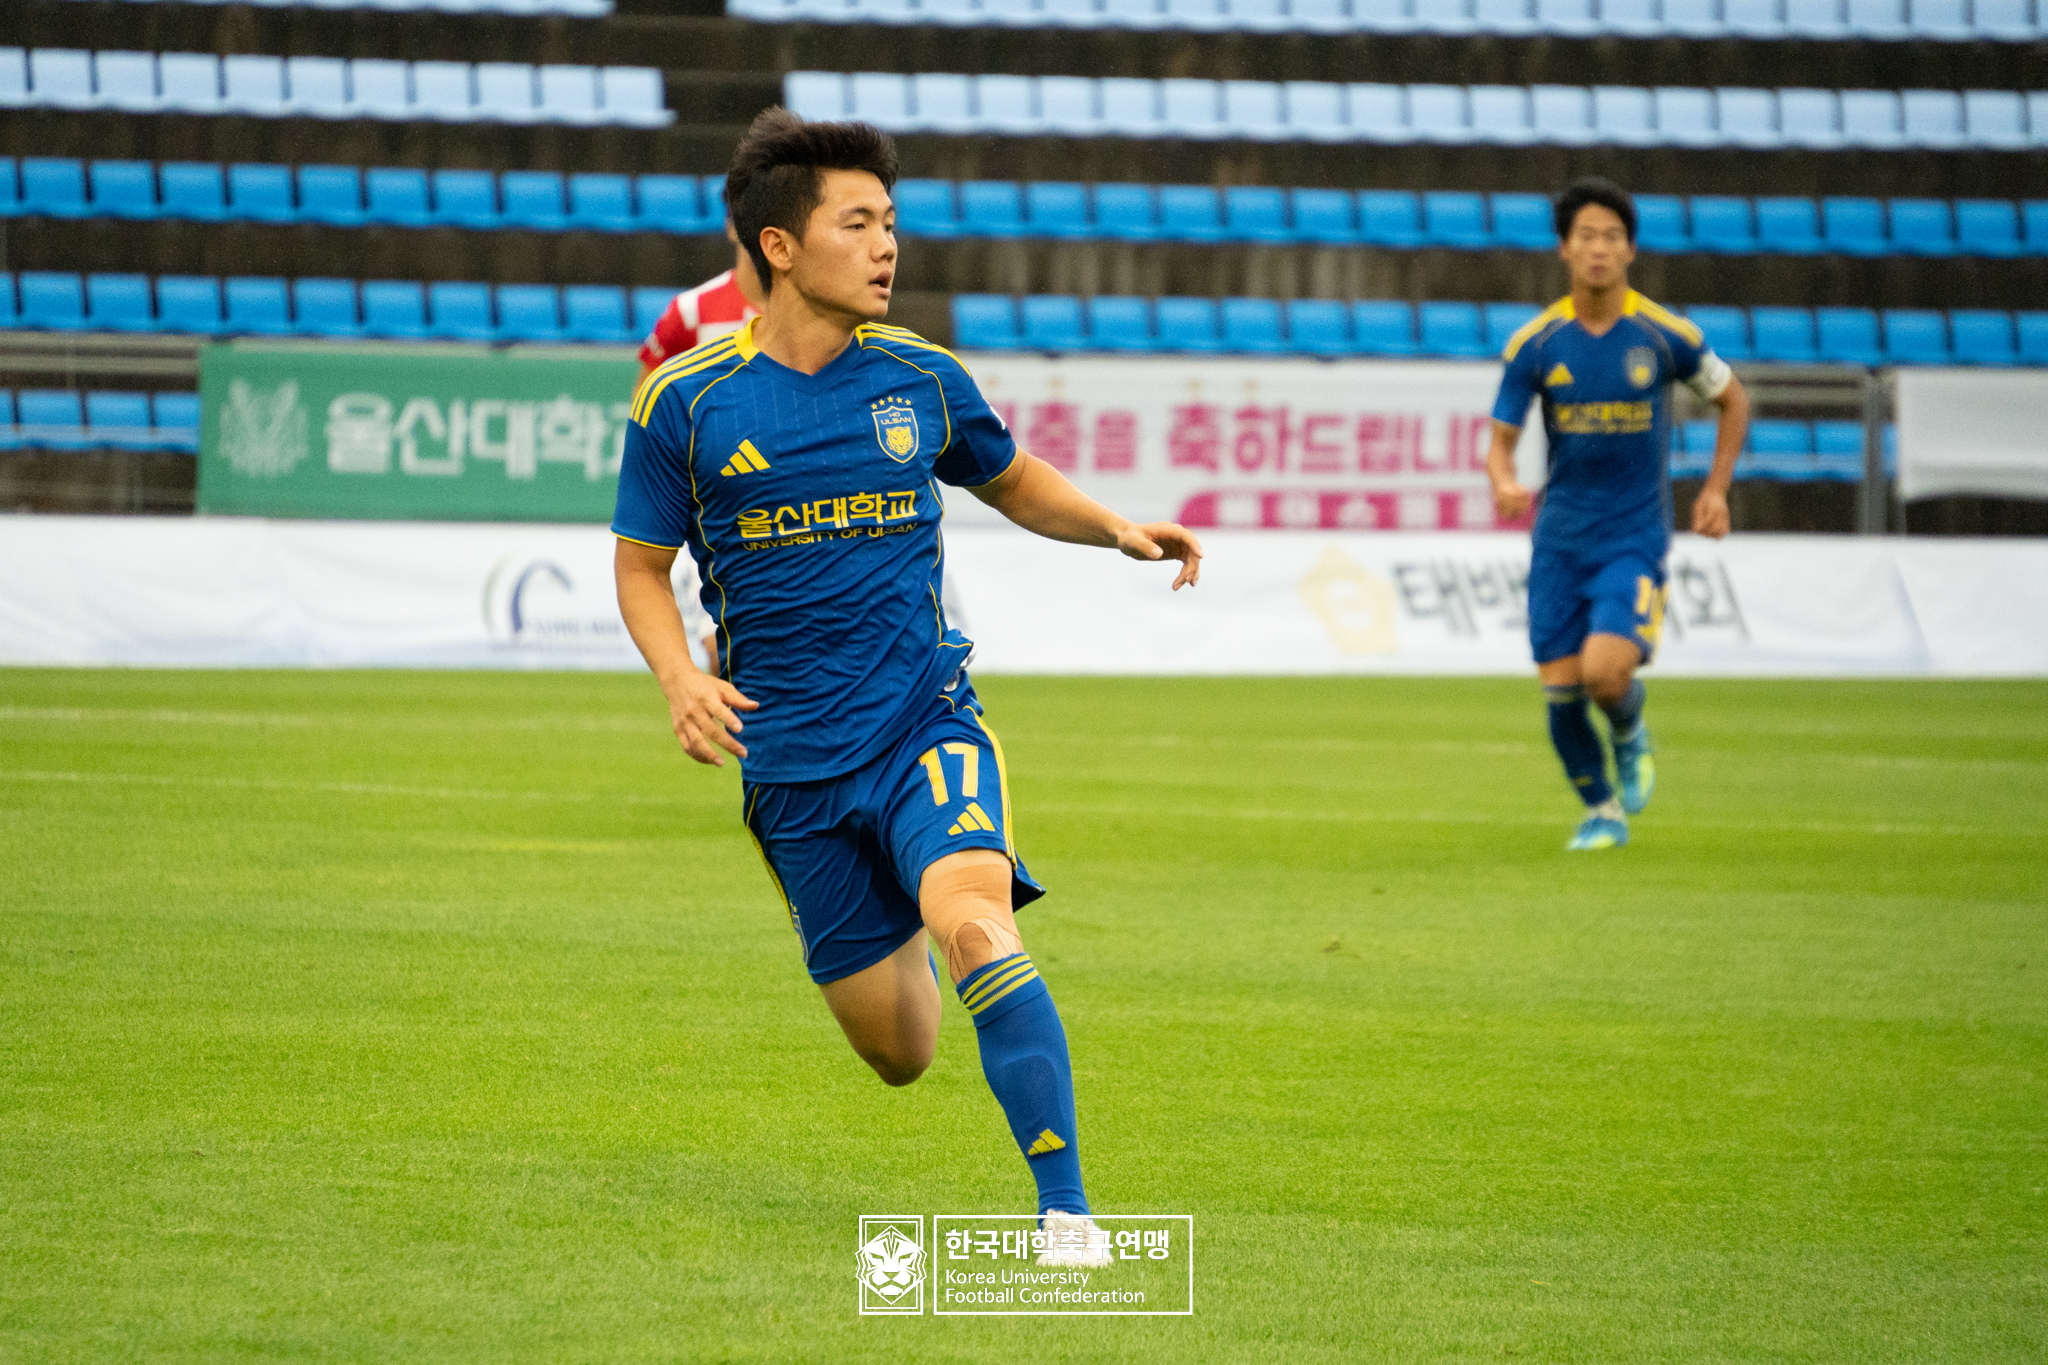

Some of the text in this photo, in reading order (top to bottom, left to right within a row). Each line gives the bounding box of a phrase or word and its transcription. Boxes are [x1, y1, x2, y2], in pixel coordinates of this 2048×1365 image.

[881, 417, 911, 425] ULSAN
[737, 491, 918, 538] 울산대학교
[742, 522, 918, 551] UNIVERSITY OF ULSAN
[918, 742, 979, 807] 17
